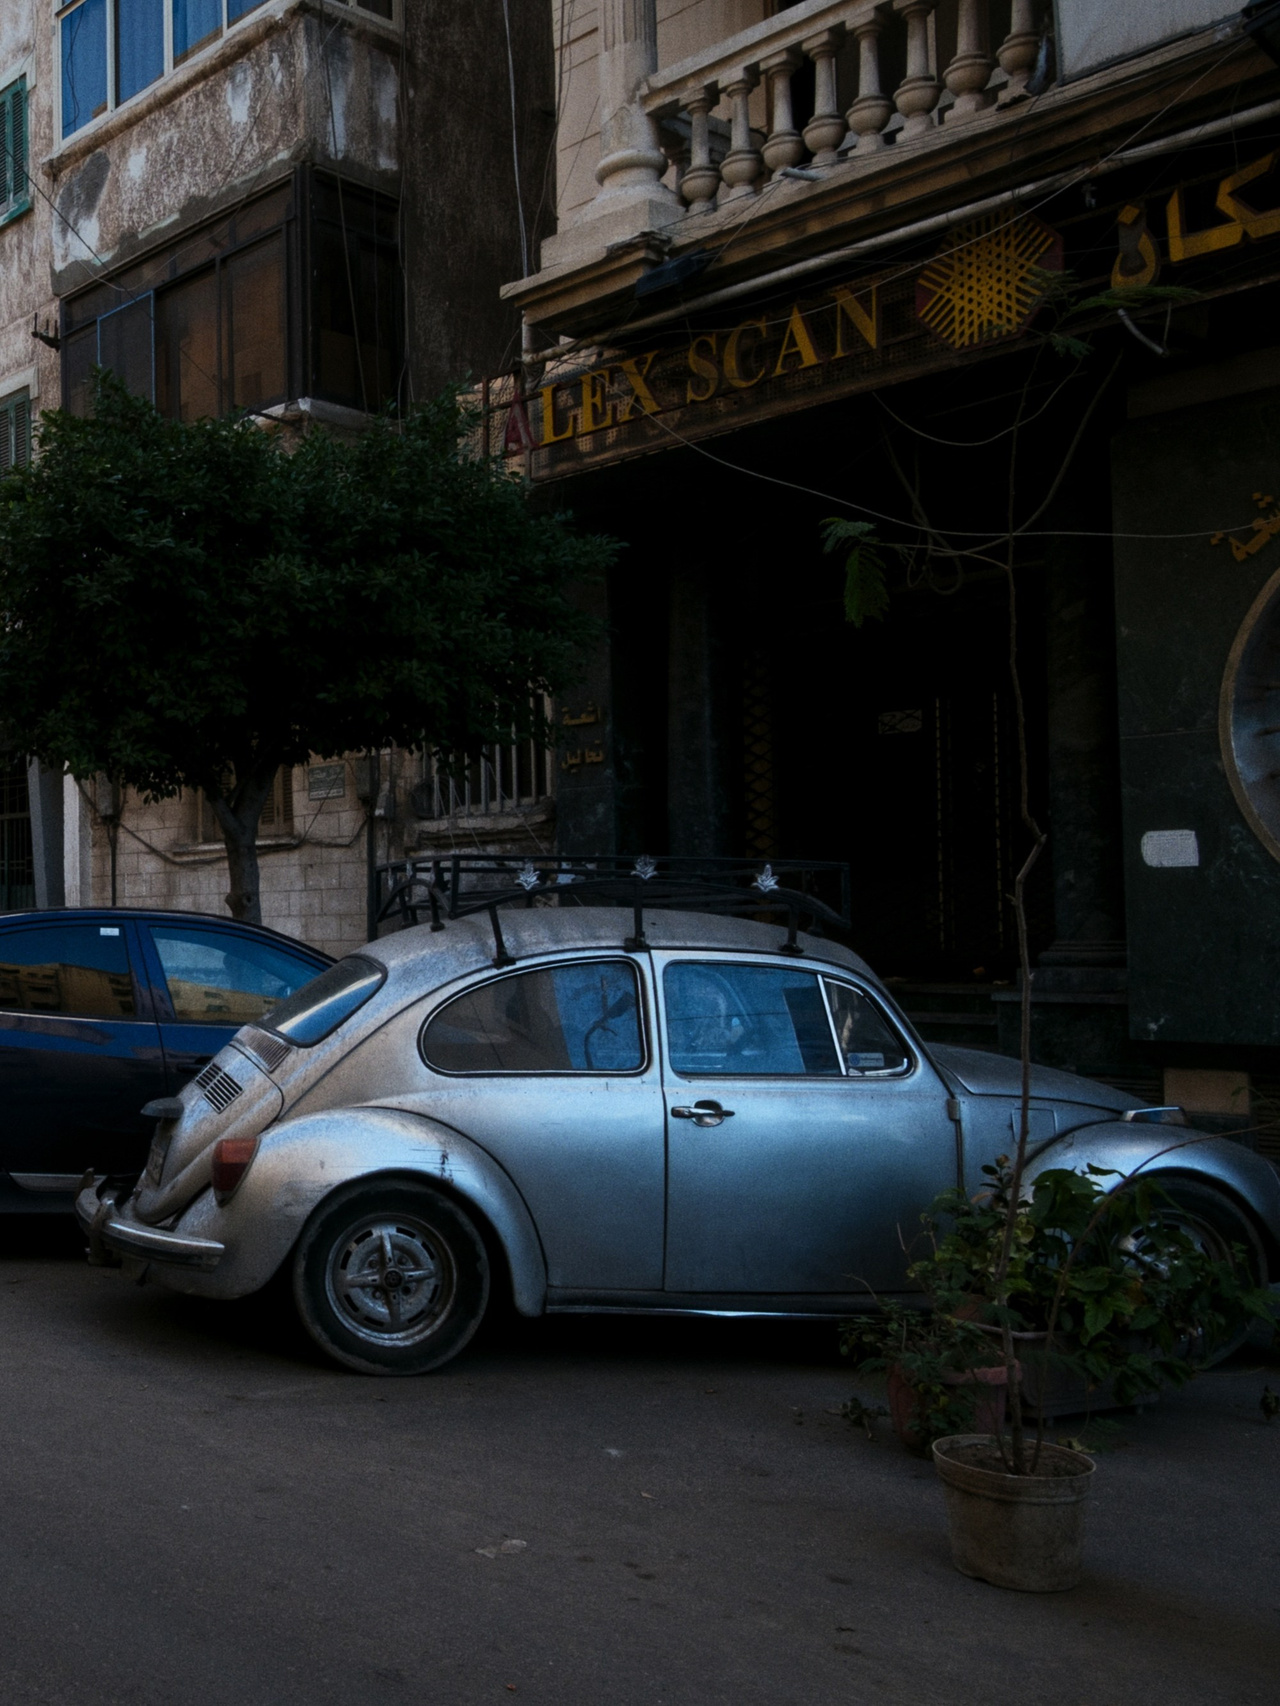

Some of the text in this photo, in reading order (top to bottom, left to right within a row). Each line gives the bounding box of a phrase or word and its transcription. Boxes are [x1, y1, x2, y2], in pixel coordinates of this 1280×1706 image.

[1111, 147, 1280, 291] كان
[504, 285, 881, 454] ALEX SCAN
